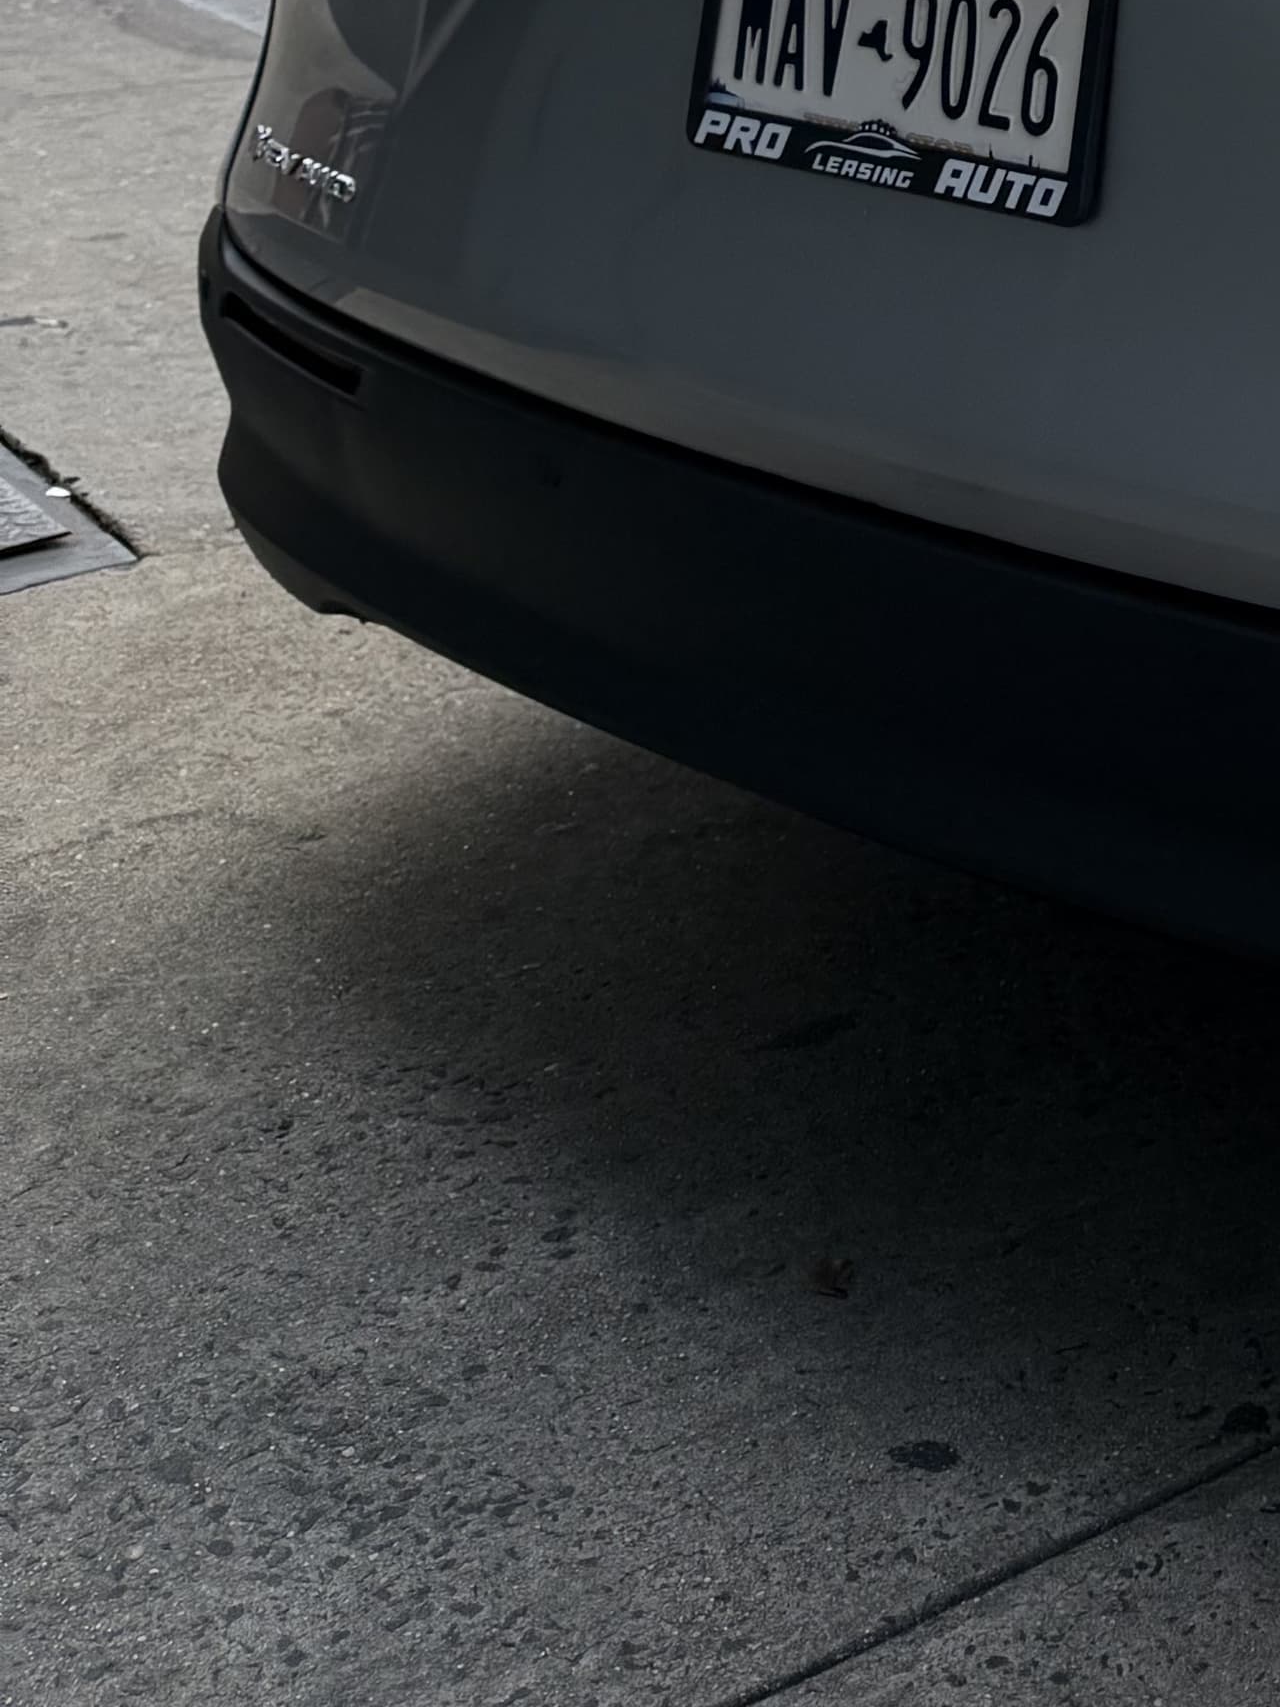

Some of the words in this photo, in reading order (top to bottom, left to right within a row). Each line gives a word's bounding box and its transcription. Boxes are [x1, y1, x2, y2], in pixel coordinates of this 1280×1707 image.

[694, 109, 793, 160] PRO
[812, 152, 914, 189] LEASING
[933, 158, 1069, 218] AUTO
